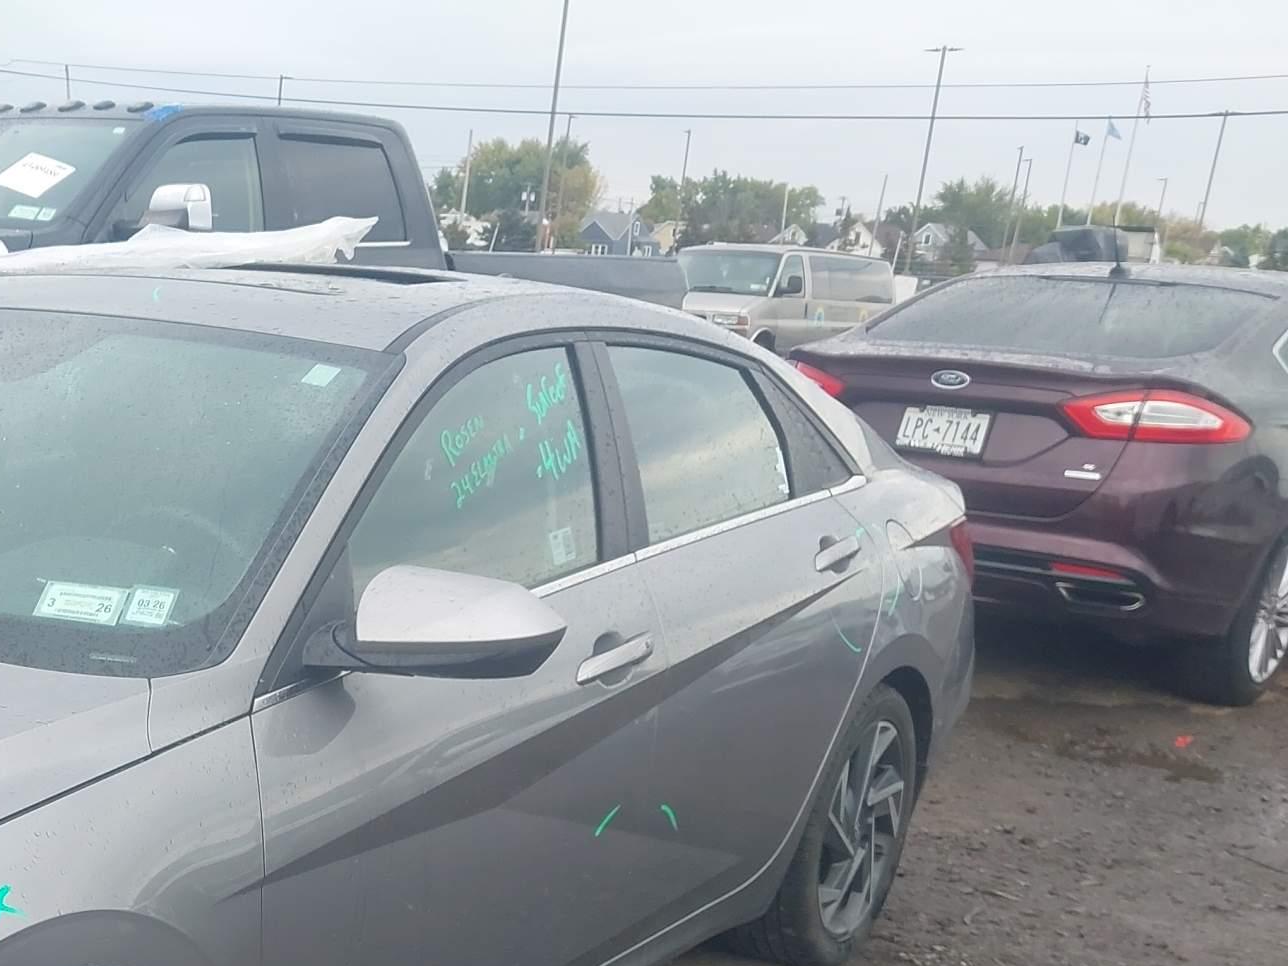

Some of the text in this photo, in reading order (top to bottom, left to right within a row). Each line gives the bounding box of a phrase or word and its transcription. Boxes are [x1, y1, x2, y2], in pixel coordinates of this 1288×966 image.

[903, 416, 981, 445] LPC 7144
[47, 597, 57, 608] 3
[95, 602, 113, 614] 26
[137, 598, 166, 610] 03 26
